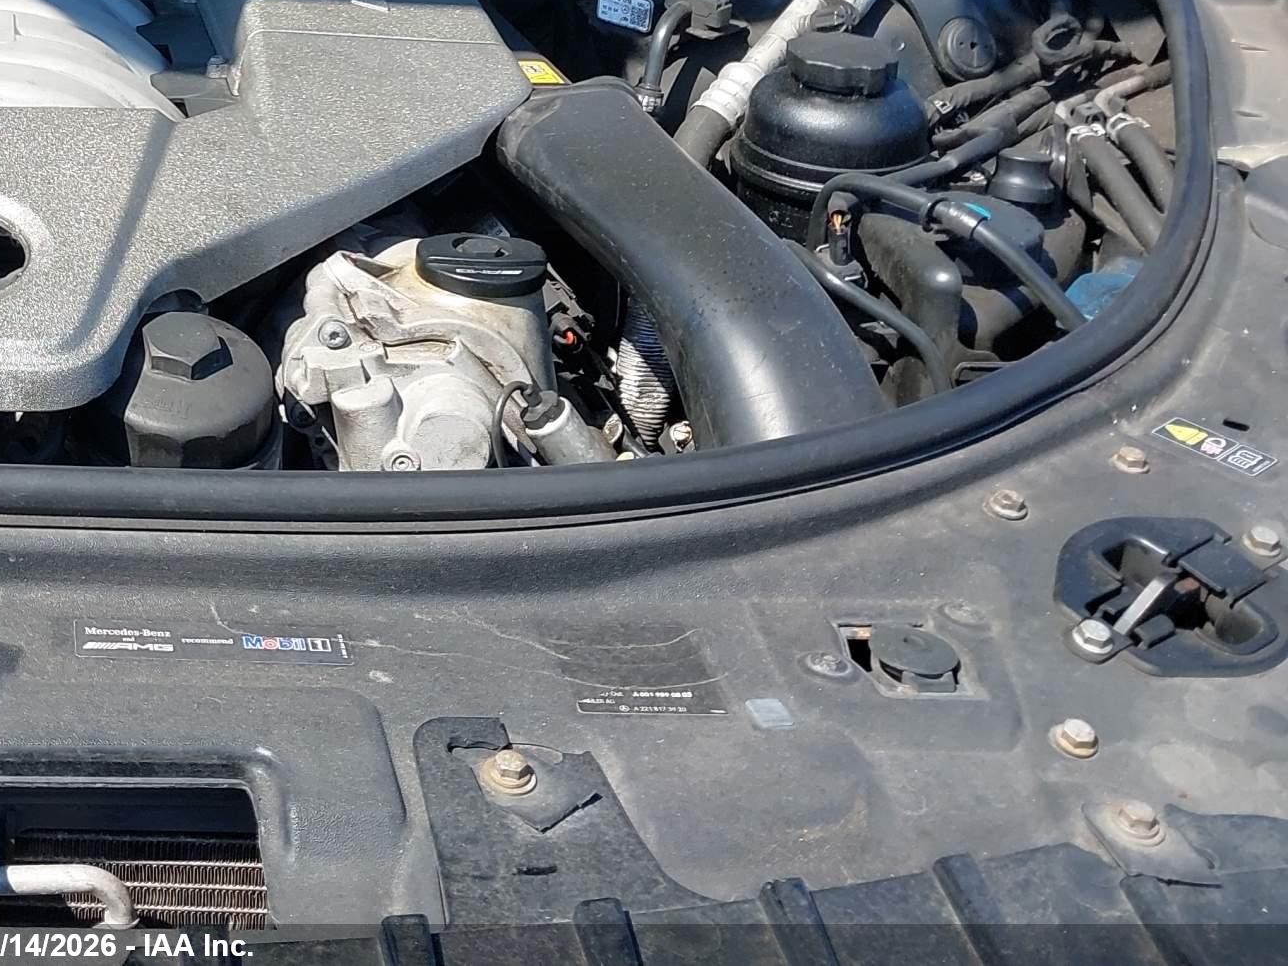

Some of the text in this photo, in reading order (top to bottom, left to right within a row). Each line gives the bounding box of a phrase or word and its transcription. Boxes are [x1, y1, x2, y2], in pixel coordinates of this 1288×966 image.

[84, 626, 171, 637] Mercedes-Benz
[181, 637, 234, 645] recommend
[242, 636, 307, 651] Mobil
